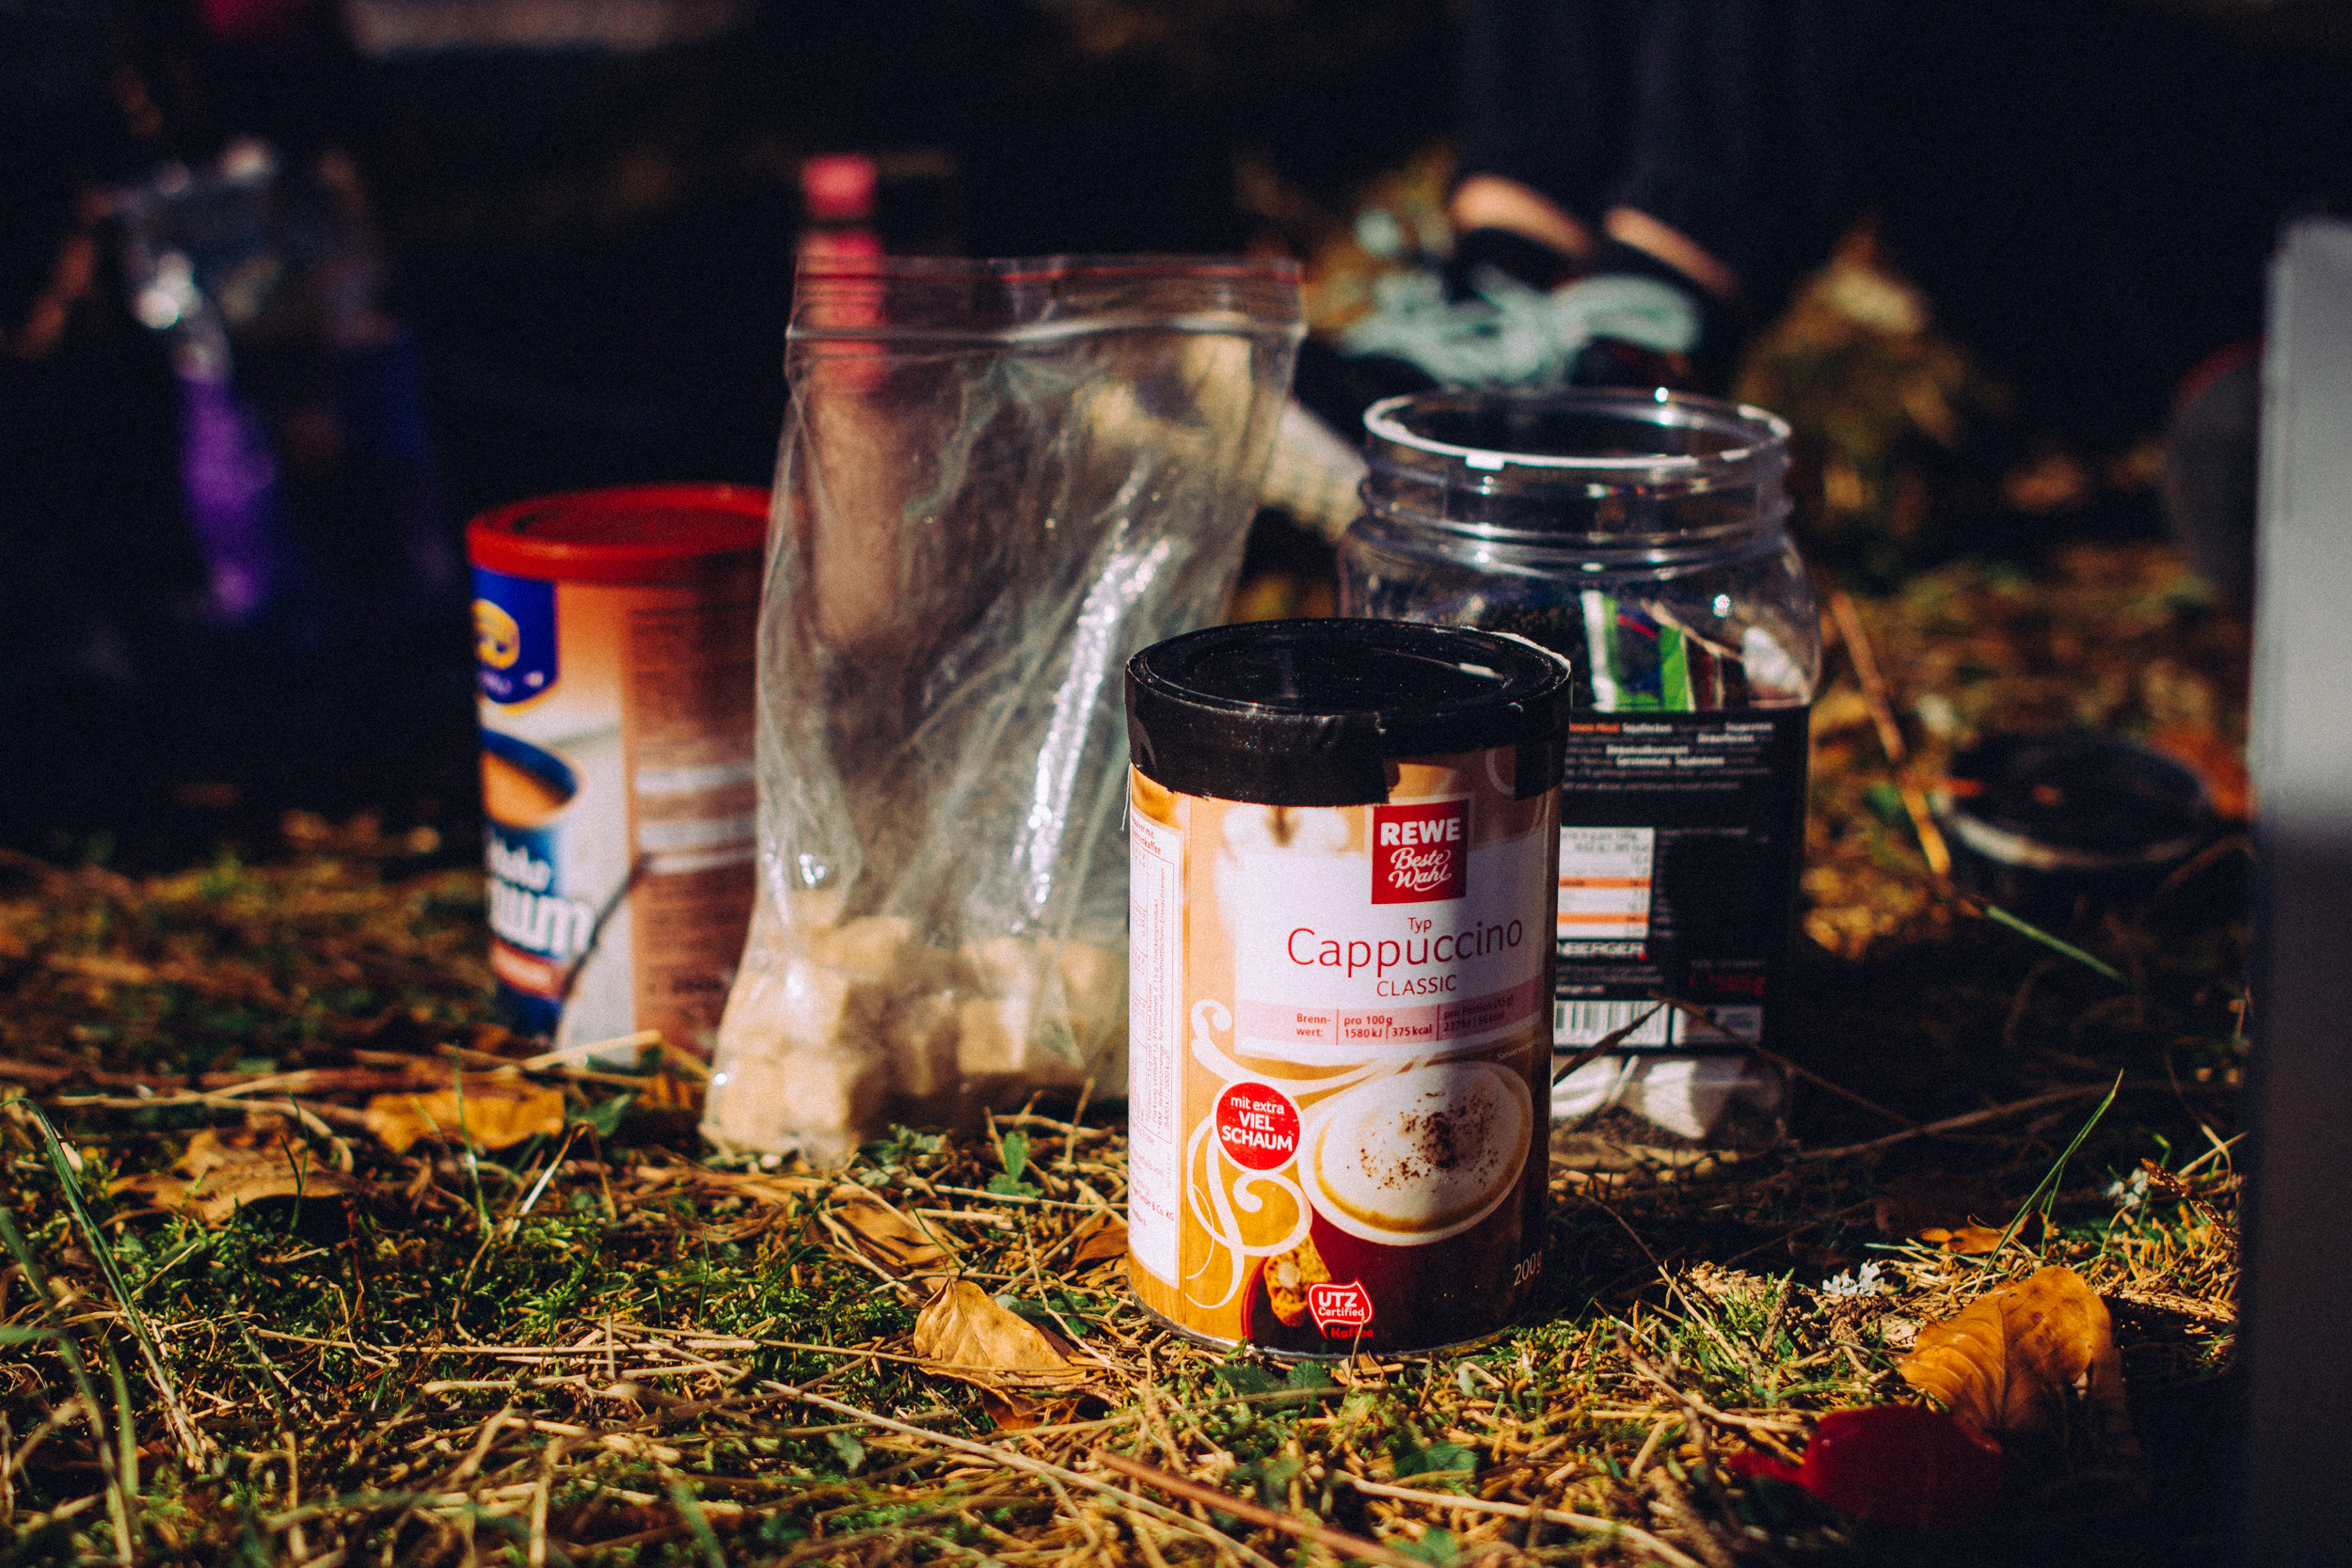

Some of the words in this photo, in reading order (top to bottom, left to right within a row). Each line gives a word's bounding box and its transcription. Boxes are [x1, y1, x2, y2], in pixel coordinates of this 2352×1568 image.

[1380, 817, 1460, 846] REWE
[1390, 847, 1452, 870] Beste
[1388, 863, 1452, 893] Wahl
[1407, 916, 1433, 934] Typ
[1287, 919, 1523, 978] Cappuccino
[1376, 974, 1457, 997] CLASSIC
[1295, 1012, 1331, 1024] Brenn-
[1343, 1017, 1362, 1027] pro
[1231, 1096, 1251, 1110] mit
[1252, 1101, 1285, 1115] extra
[1238, 1110, 1275, 1132] VIEL
[1221, 1125, 1294, 1152] SCHAUM
[1318, 1291, 1358, 1307] UTZ
[1318, 1307, 1364, 1317] Certified
[1330, 1326, 1374, 1338] Kaffee
